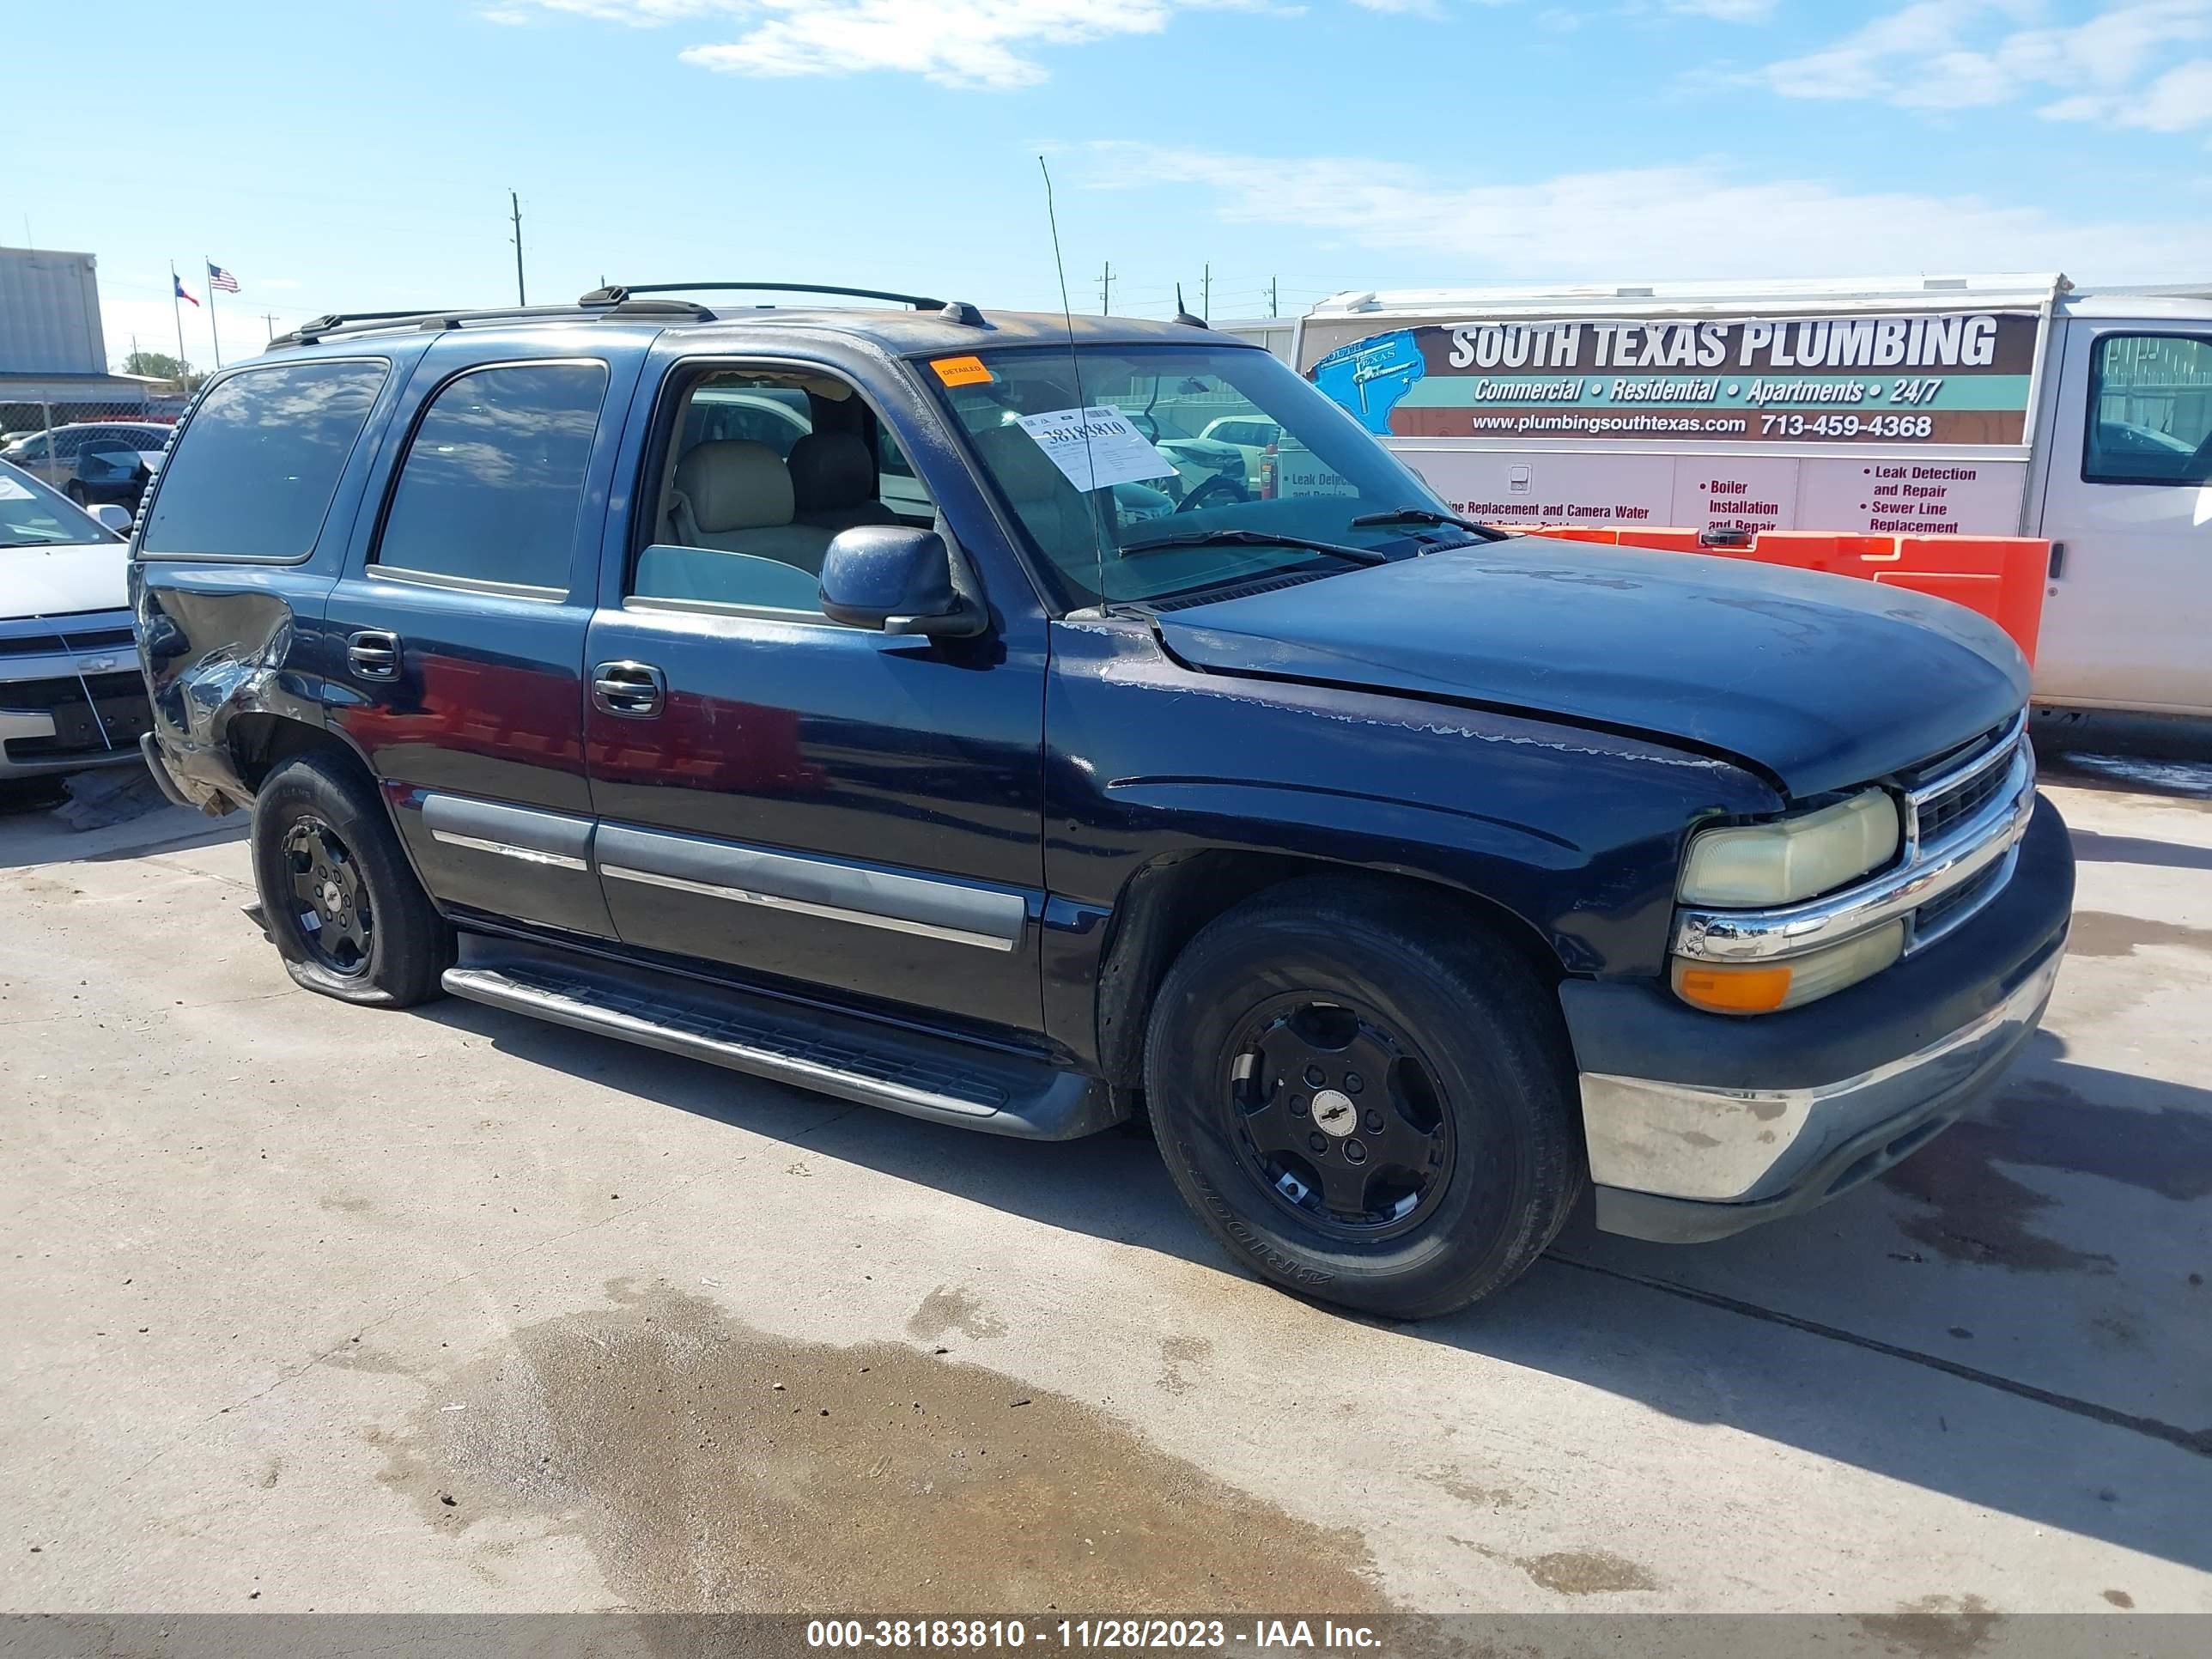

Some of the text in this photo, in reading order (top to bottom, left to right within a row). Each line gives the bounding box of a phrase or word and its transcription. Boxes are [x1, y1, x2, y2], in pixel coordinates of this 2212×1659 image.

[1449, 315, 1997, 368] SOUTH TEXAS PLUMBING
[942, 366, 981, 376] DETAILED
[1474, 378, 1942, 406] Commercial Residential Apartments 24/7
[1473, 414, 1932, 436] www.plumbingsouthtexas.com 713-459-4368
[1042, 421, 1127, 445] 38183810
[1292, 473, 1316, 486] Leak
[1875, 466, 1977, 481] Leak Detection
[1711, 480, 1748, 495] Boiler
[1874, 484, 1948, 499] and Repair
[1468, 501, 1540, 515] Replacement
[1543, 503, 1564, 516] and
[1567, 504, 1611, 518] Camera
[1615, 505, 1650, 520] Water
[1710, 500, 1778, 515] Installation
[1872, 501, 1948, 515] Sewer Line
[1869, 518, 1959, 534] Replacement
